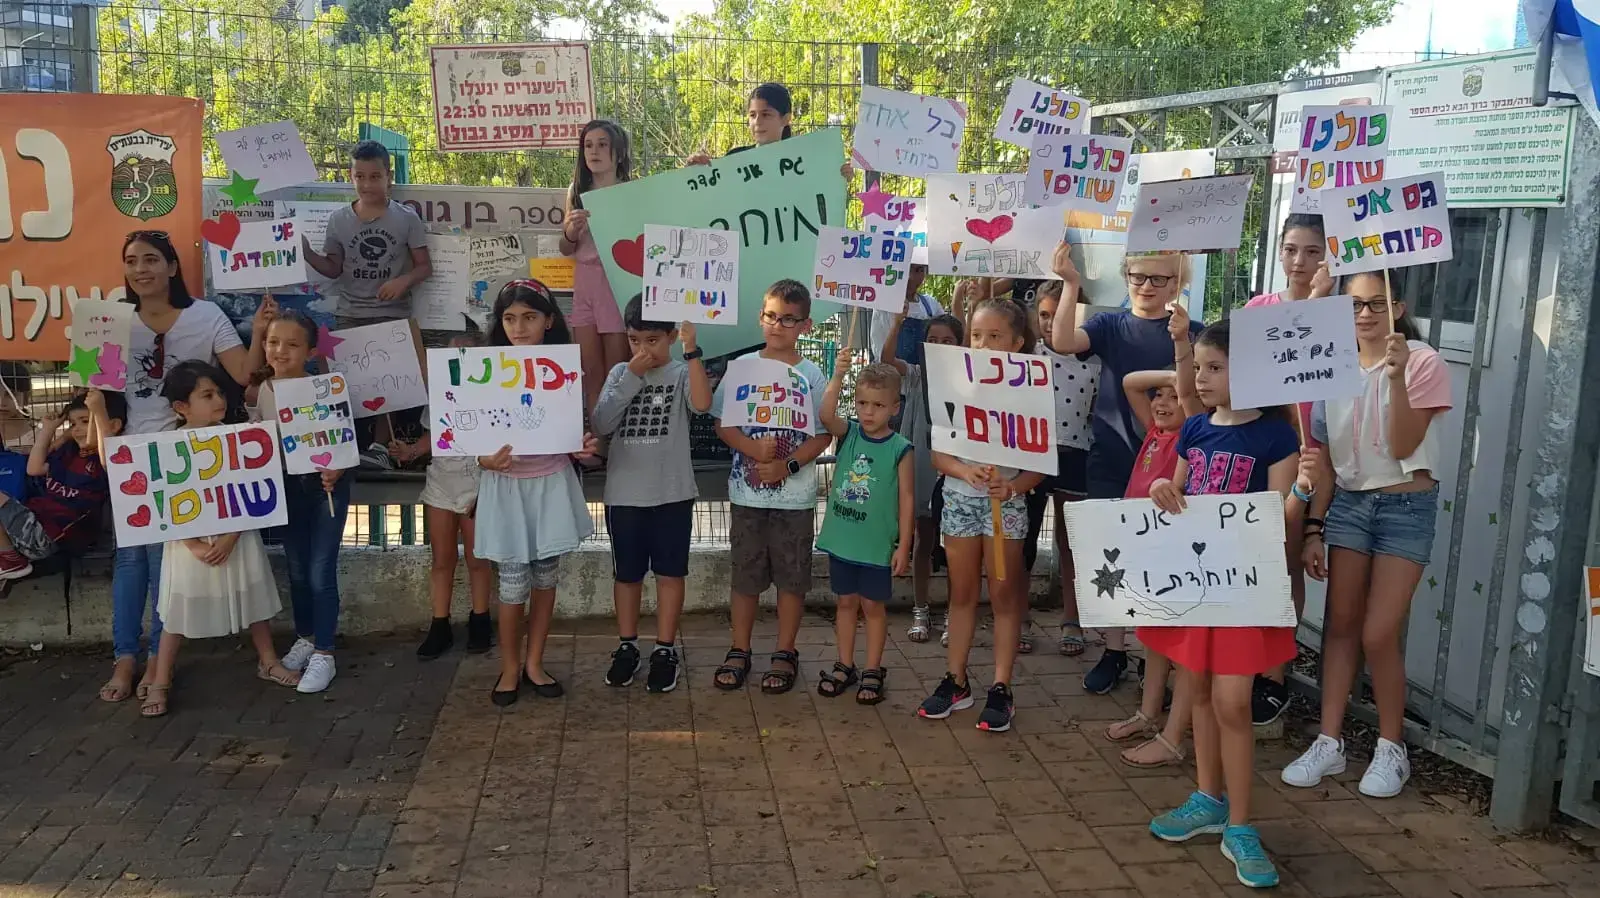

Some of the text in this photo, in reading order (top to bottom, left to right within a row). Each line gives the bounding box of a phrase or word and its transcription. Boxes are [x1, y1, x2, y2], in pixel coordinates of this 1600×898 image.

[459, 80, 567, 97] השערים ינעלו
[1305, 74, 1354, 90] המקום מוגן
[443, 100, 586, 119] החל מהשעה 22:30
[1030, 91, 1080, 120] כולנו
[1409, 106, 1430, 116] הספר
[1432, 103, 1450, 113] לבית
[1452, 103, 1468, 112] הבא
[1471, 100, 1488, 111] ברוך
[444, 124, 488, 142] גבול!
[493, 125, 534, 140] מסיג
[862, 102, 956, 139] כל אחד
[1301, 110, 1387, 152] כולנו
[271, 131, 289, 143] גם
[1063, 138, 1126, 174] כולנו
[687, 156, 805, 191] גם אני ילדה
[1041, 169, 1115, 204] שווים!
[1297, 158, 1385, 194] שווים!
[255, 210, 274, 218] נוער
[464, 201, 498, 229] בן
[887, 200, 917, 222] אני
[1347, 181, 1438, 222] גם אני
[271, 222, 294, 243] אני
[221, 245, 297, 274] מיוחדת!
[840, 233, 873, 260] אני
[881, 239, 907, 263] גם
[950, 241, 1045, 276] אחד!
[1326, 225, 1444, 268] מיוחדת!
[353, 266, 391, 280] BEGIN
[869, 264, 904, 286] ילד
[814, 274, 876, 303] מיוחד!
[1273, 341, 1334, 364] גם אני
[448, 351, 566, 391] כולנו
[787, 367, 809, 395] כל
[1283, 367, 1334, 385] מיוחדת
[312, 375, 345, 400] כל
[735, 381, 805, 408] הילדים
[278, 400, 350, 424] הילדים
[746, 402, 808, 429] שווים!
[282, 427, 354, 454] מיוחדים
[148, 427, 275, 485] כולנו
[153, 477, 278, 531] שווים!
[1120, 501, 1260, 536] גם אני
[1143, 565, 1258, 596] מיוחדת!
